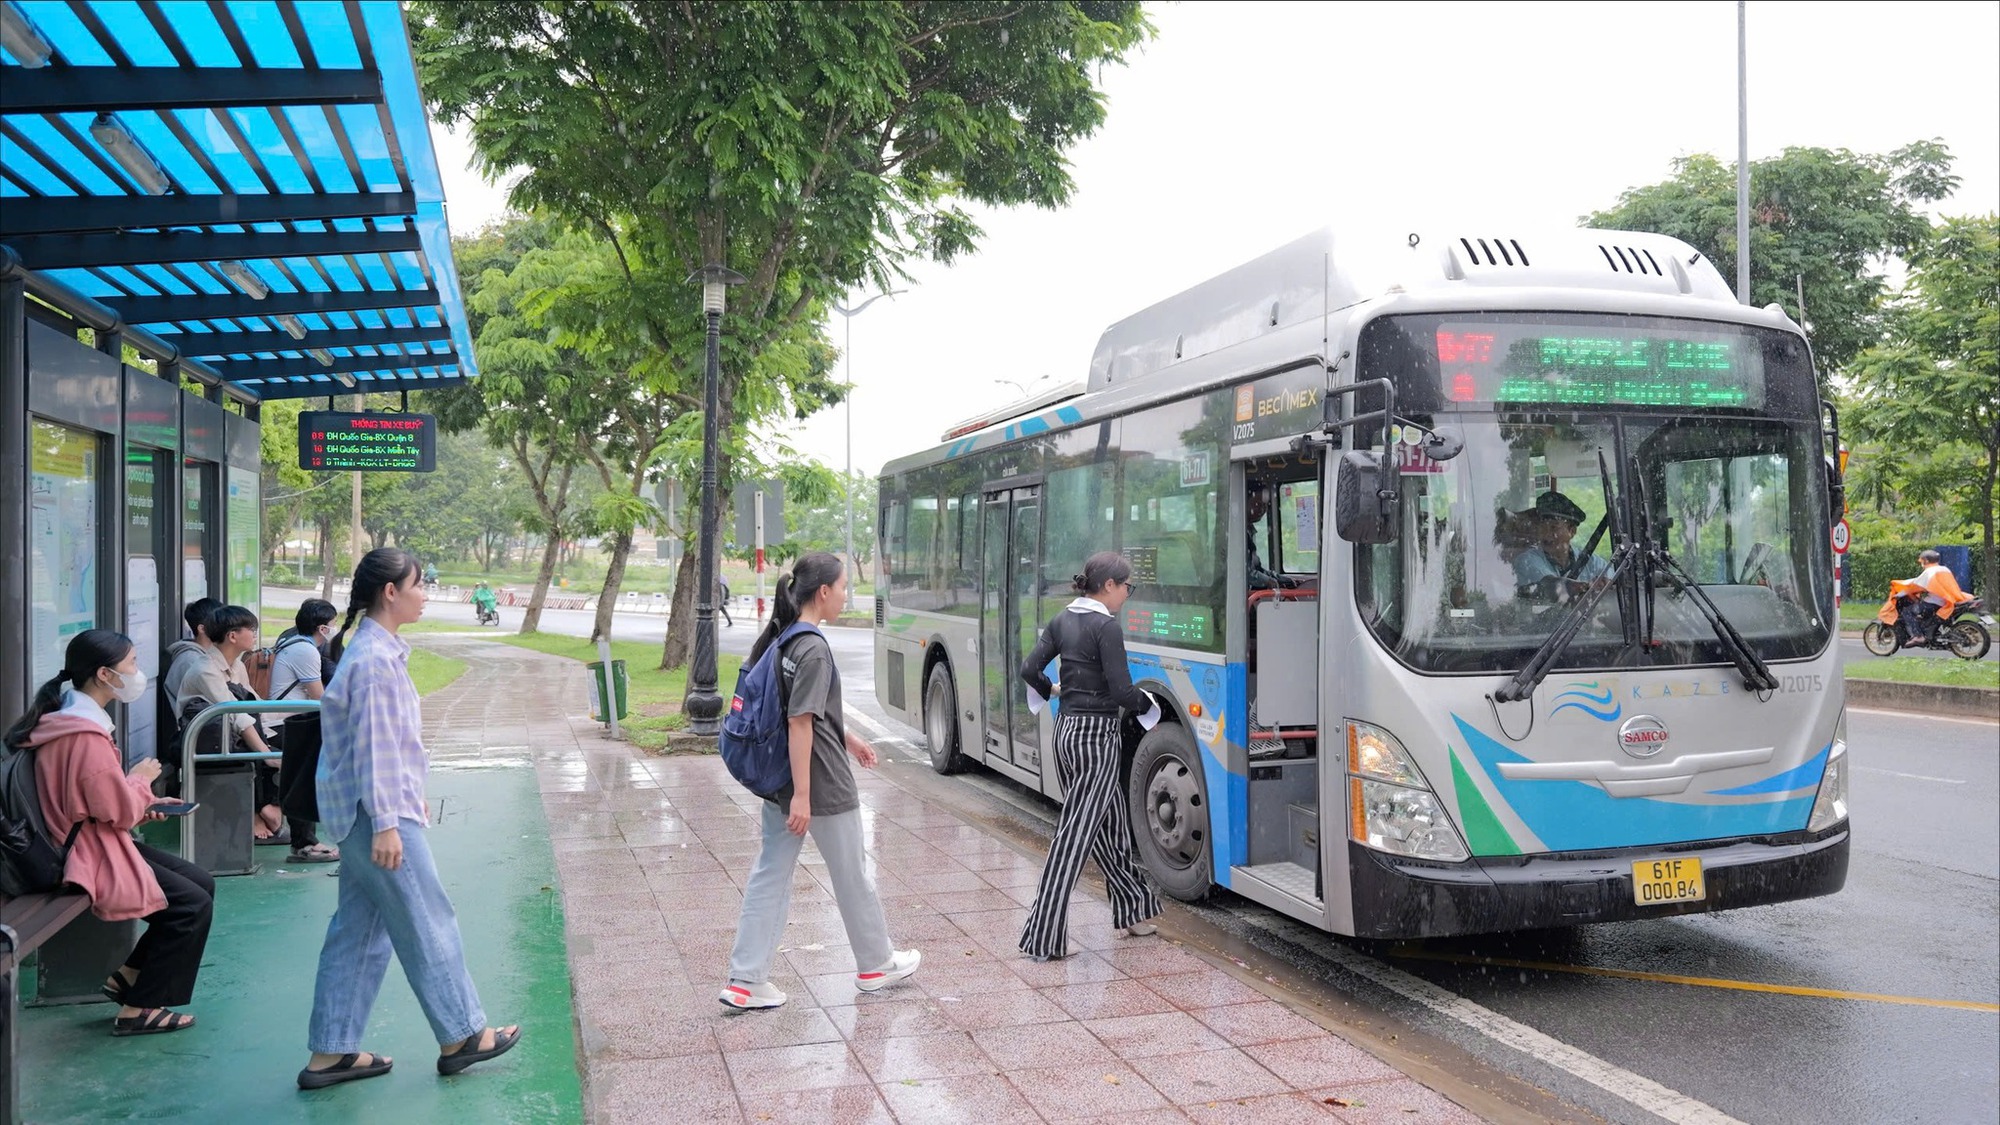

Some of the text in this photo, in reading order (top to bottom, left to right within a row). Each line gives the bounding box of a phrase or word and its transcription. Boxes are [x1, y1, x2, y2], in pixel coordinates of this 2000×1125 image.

[351, 418, 424, 429] THÔNG TIN XE BUÝ
[311, 432, 325, 440] 08
[326, 432, 338, 440] ĐH
[339, 432, 359, 441] Quốc
[387, 433, 407, 443] Quận
[1233, 422, 1255, 440] V2075
[326, 445, 338, 453] ĐH
[339, 445, 359, 454] Quốc
[407, 447, 419, 456] Tây
[1835, 528, 1846, 543] 40
[1625, 730, 1668, 743] SAMCO
[1653, 861, 1682, 879] 61F
[1642, 880, 1697, 901] 000.84
